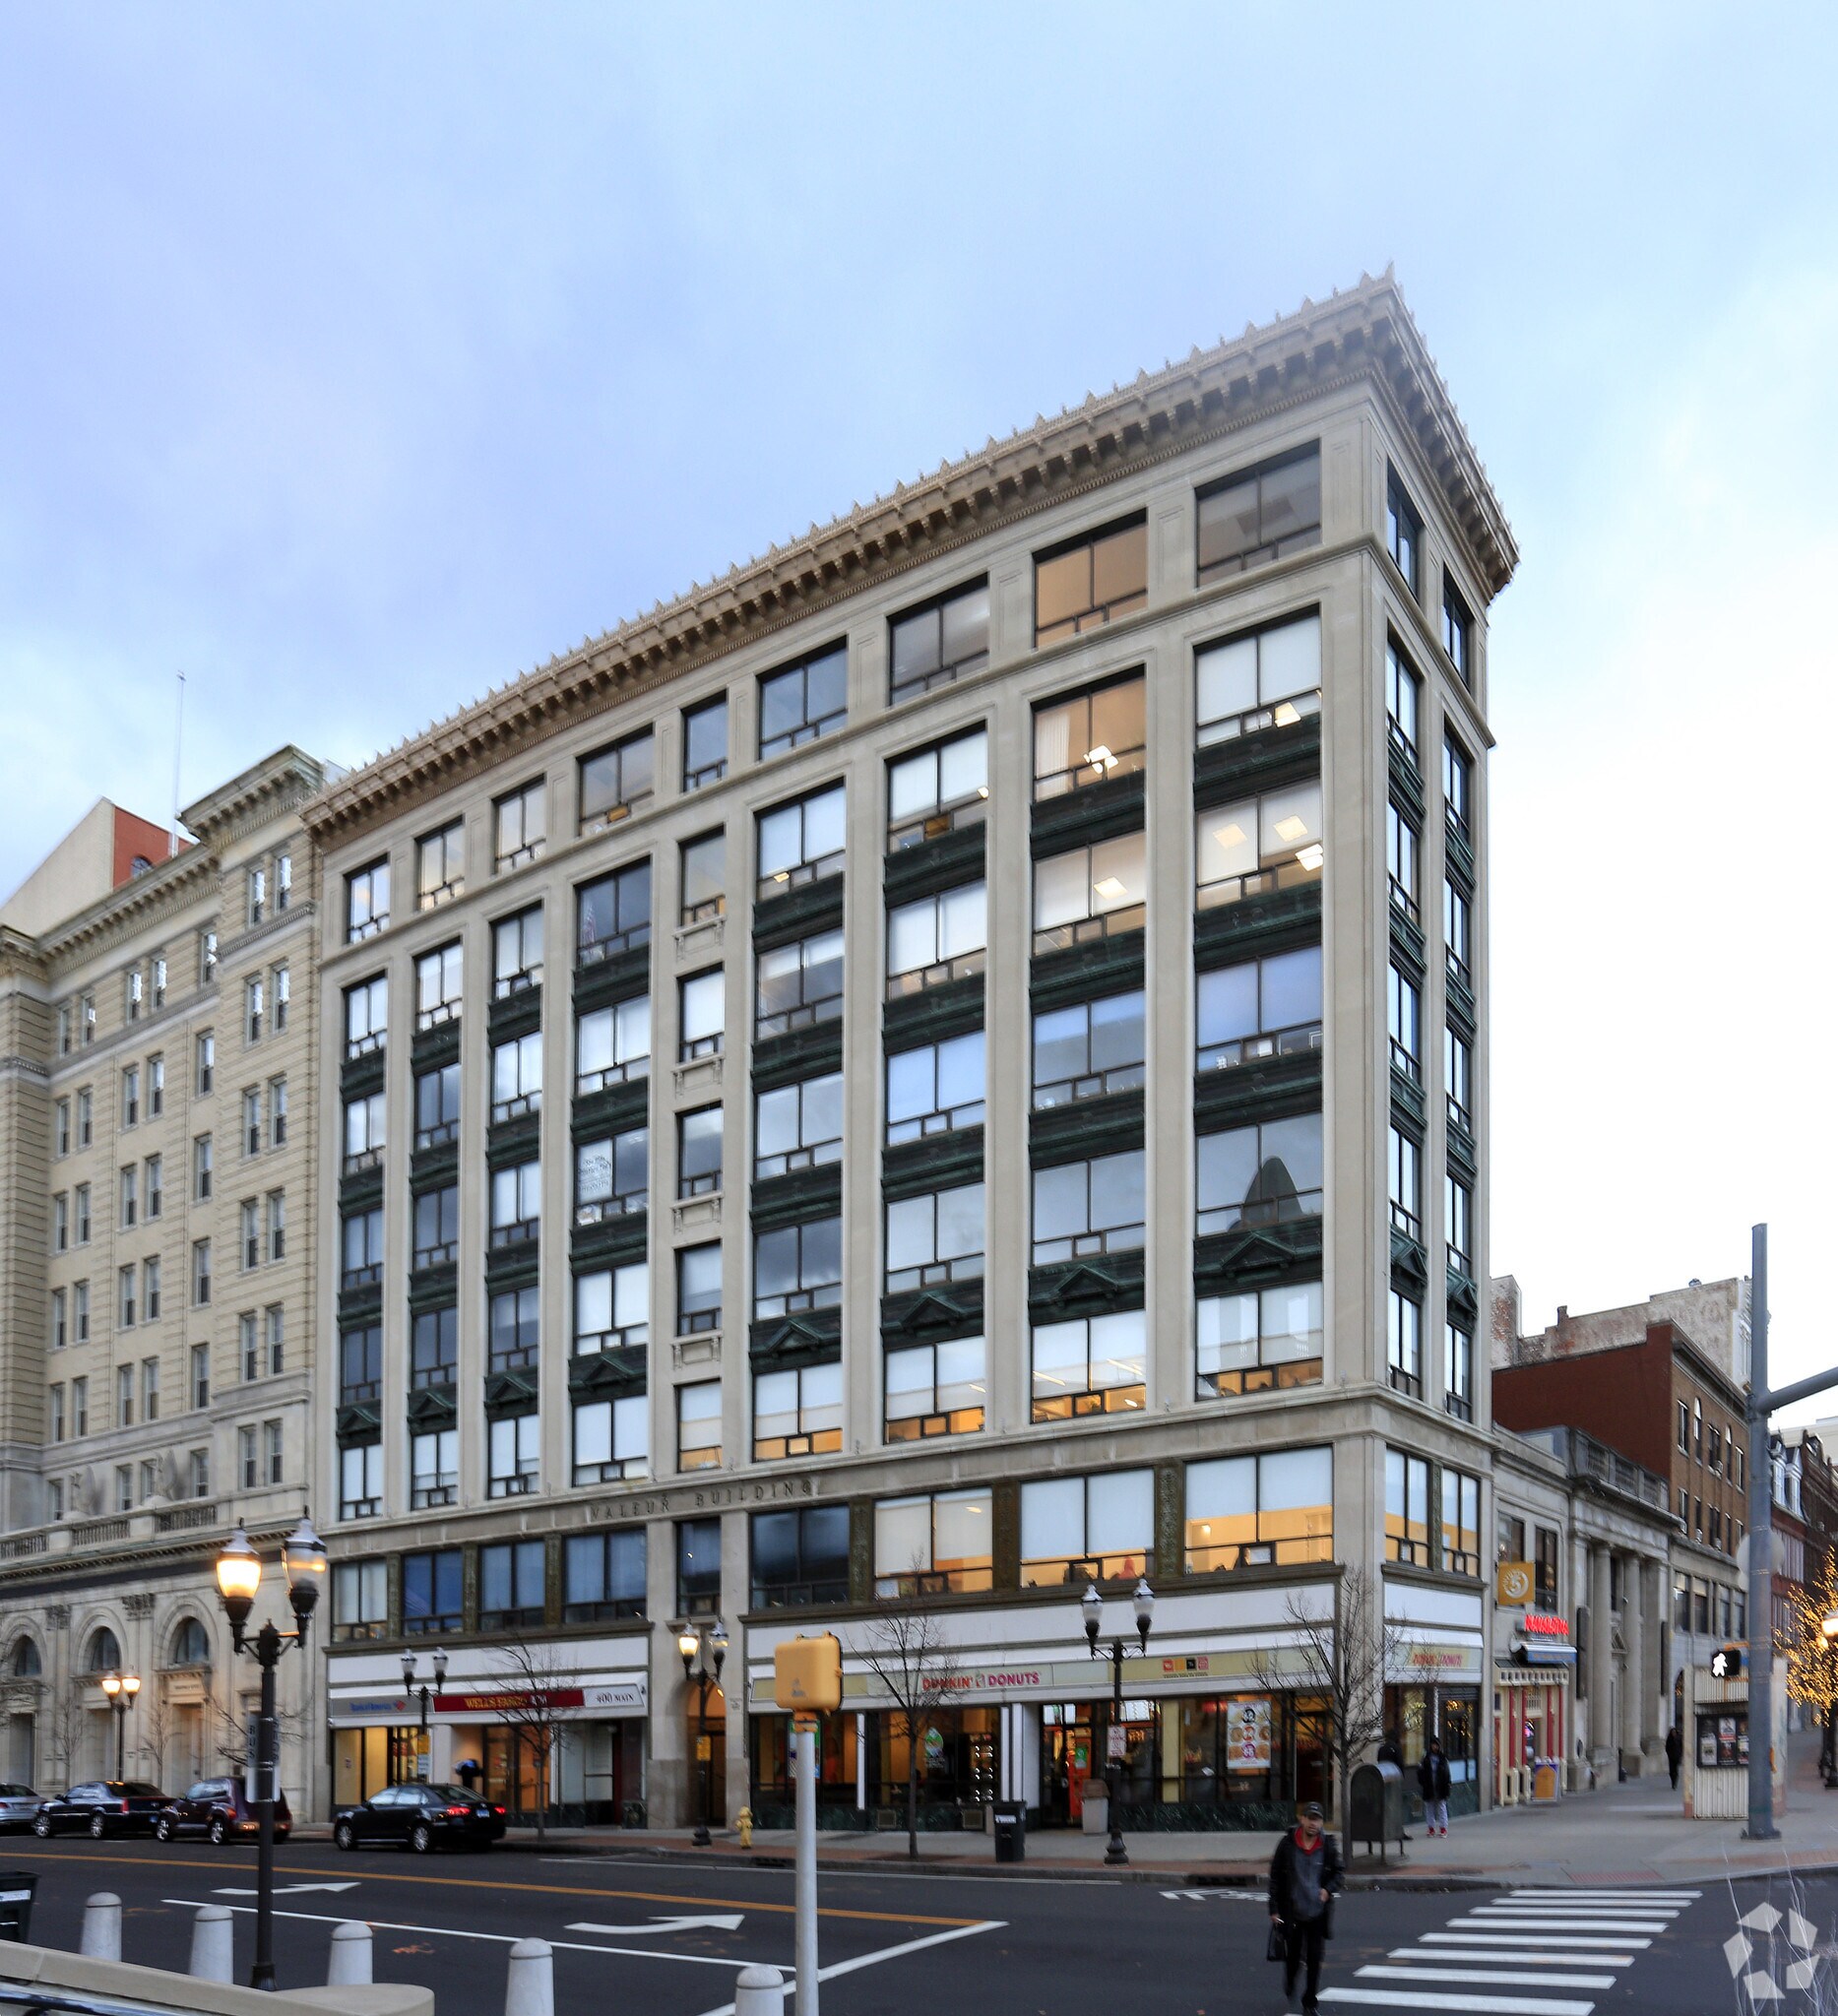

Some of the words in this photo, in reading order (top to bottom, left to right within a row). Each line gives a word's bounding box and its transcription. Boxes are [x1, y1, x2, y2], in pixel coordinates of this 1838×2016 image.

[590, 1495, 669, 1520] VALEUR
[695, 1479, 812, 1507] BUILDING
[987, 1670, 1041, 1686] DONUTS
[464, 1697, 495, 1710] WELLS
[596, 1692, 612, 1703] 400
[613, 1692, 635, 1703] MAIN
